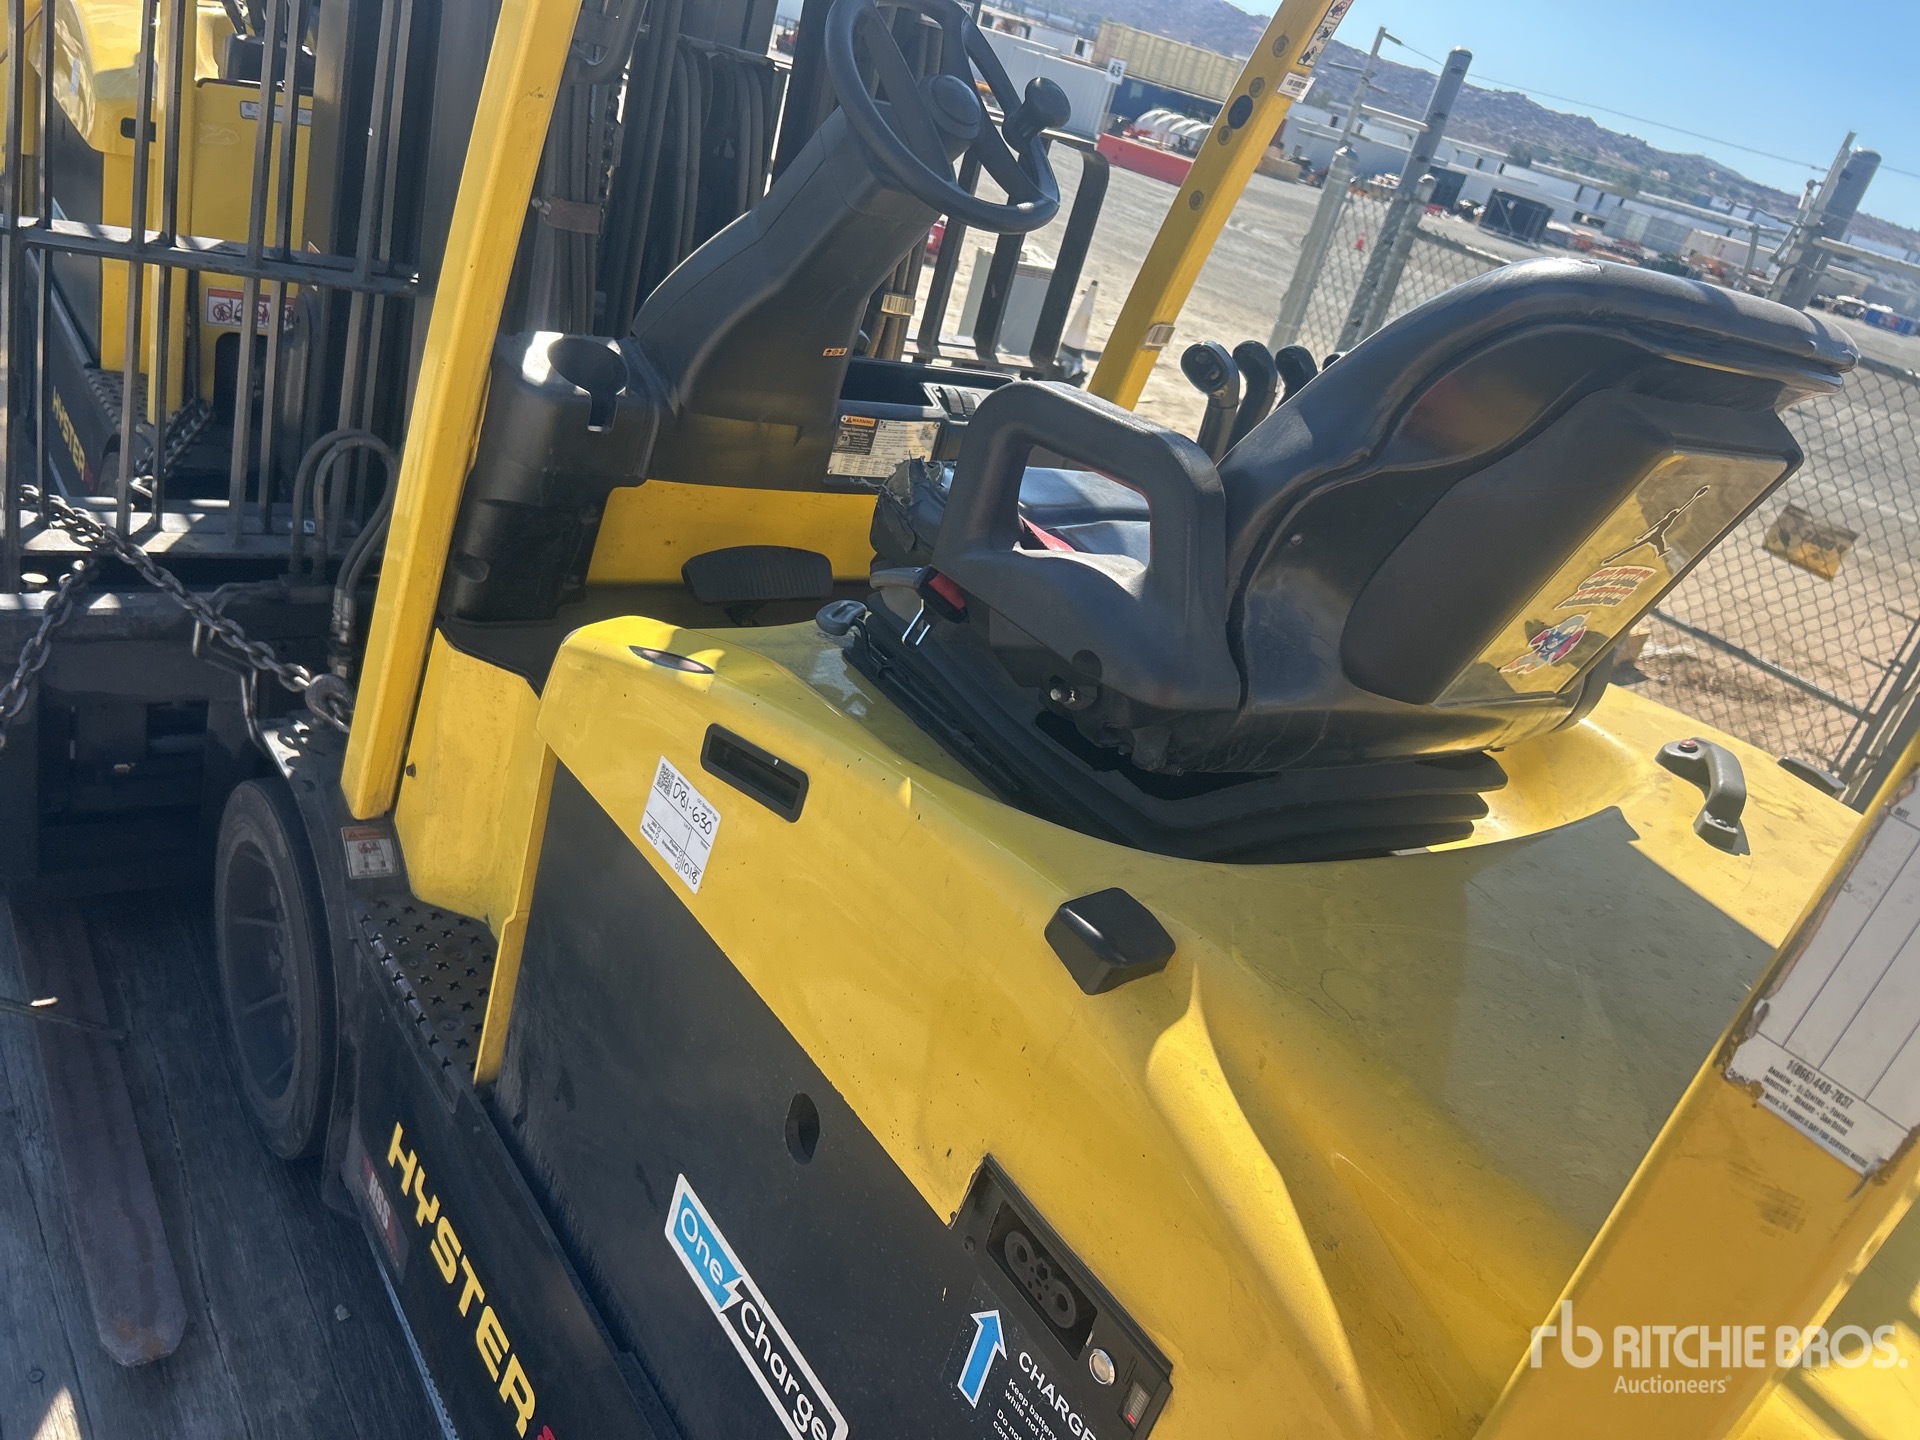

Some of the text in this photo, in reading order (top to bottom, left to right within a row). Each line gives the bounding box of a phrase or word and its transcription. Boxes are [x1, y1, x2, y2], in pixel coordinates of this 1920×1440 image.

[52, 386, 86, 480] HYSTER
[387, 1121, 536, 1439] HYSTER
[680, 1207, 828, 1440] One Charge
[997, 1408, 1008, 1426] Do
[1004, 1389, 1025, 1417] while
[1025, 1416, 1040, 1437] not
[1008, 1378, 1029, 1407] Keep
